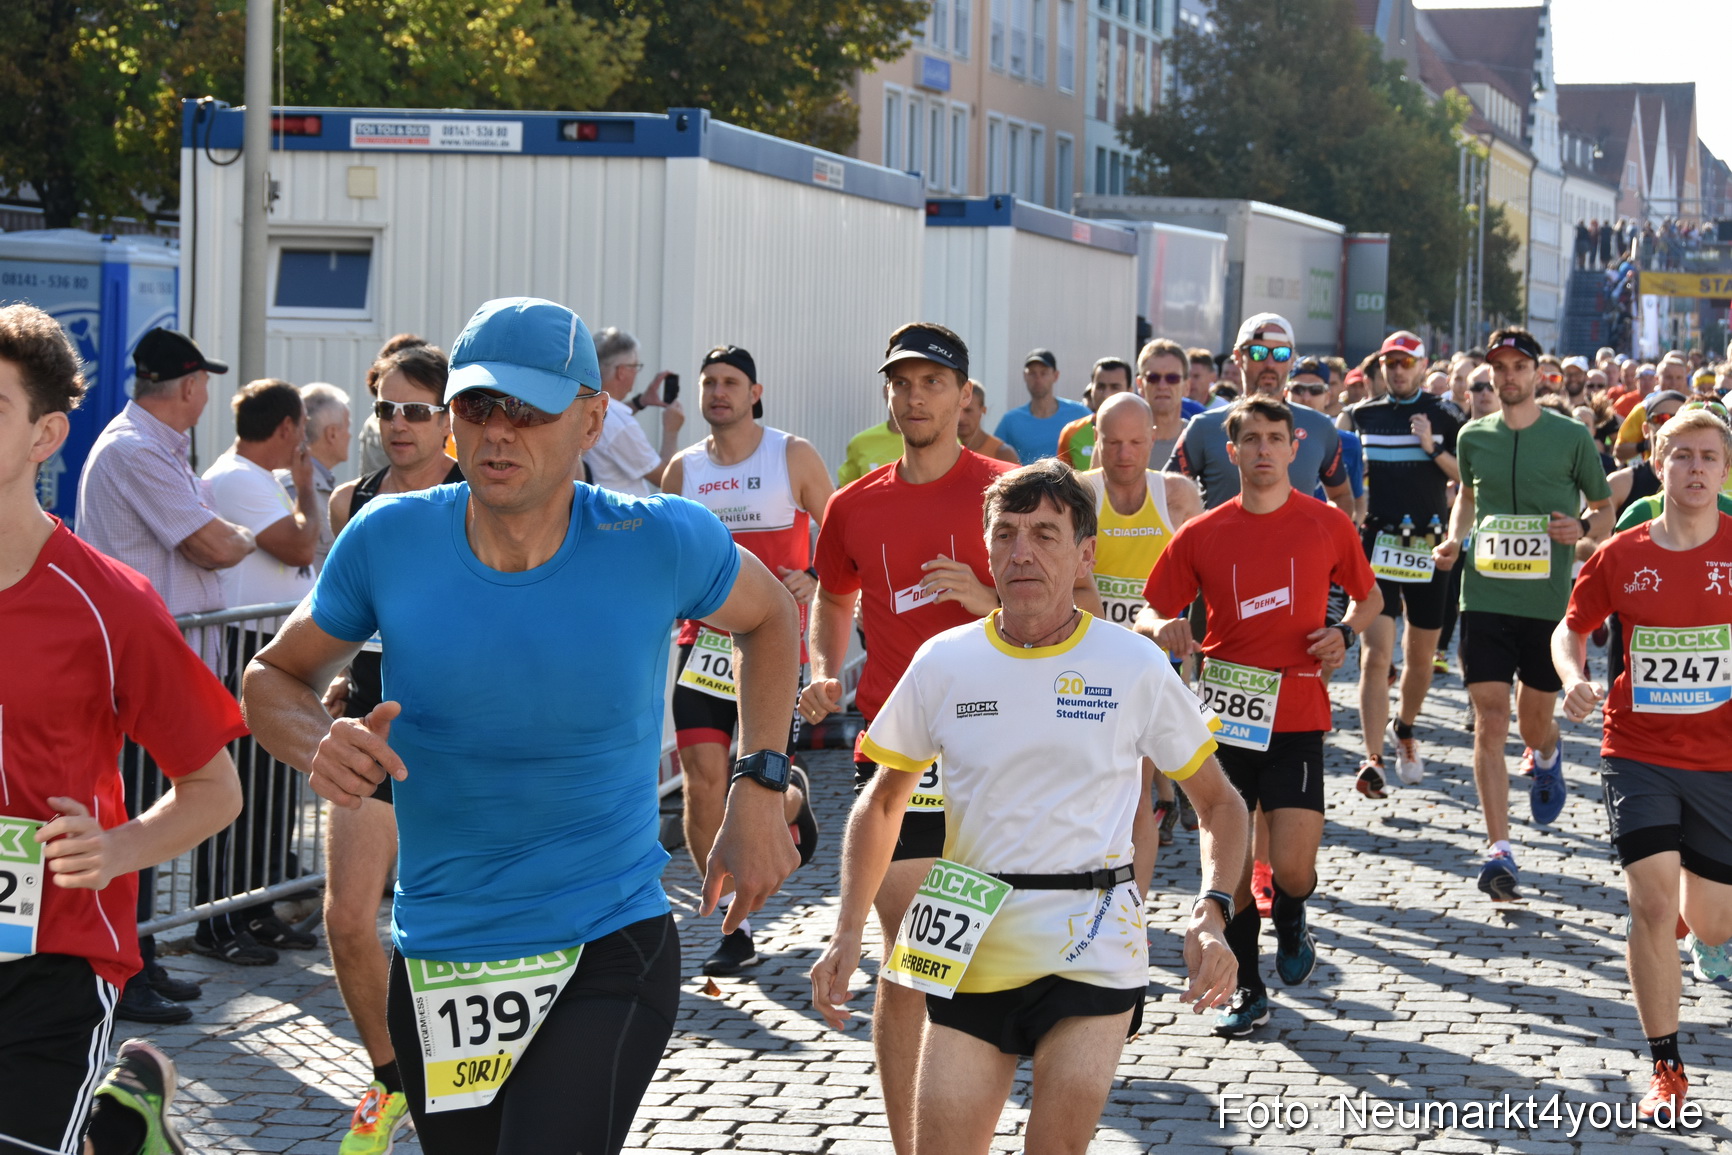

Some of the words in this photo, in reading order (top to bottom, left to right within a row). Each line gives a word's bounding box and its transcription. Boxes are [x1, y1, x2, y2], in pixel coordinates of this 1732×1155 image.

[2, 272, 37, 286] 08141
[49, 274, 70, 289] 536
[73, 275, 89, 290] 80
[928, 343, 953, 359] 2XU
[698, 477, 739, 495] speck
[613, 517, 643, 532] cep
[1113, 527, 1163, 537] DIADORA
[1486, 537, 1541, 557] 1102
[1381, 549, 1428, 569] 1196
[1492, 562, 1532, 571] EUGEN
[1254, 596, 1276, 610] DEHN
[1637, 629, 1723, 650] BOCK
[1207, 664, 1271, 692] BOCK
[1641, 656, 1720, 683] 2247
[1057, 677, 1083, 695] 20
[1086, 687, 1110, 695] JAHRE
[1056, 697, 1119, 709] Neumarkter
[1204, 687, 1265, 721] 2586
[1649, 690, 1715, 703] MANUEL
[956, 700, 999, 715] BOCK
[1056, 709, 1106, 722] Stadtlauf
[1217, 724, 1250, 738] FAN
[908, 902, 971, 953] 1052
[1065, 940, 1091, 963] 14./15.
[1087, 906, 1107, 941] September
[900, 952, 952, 980] HERBERT
